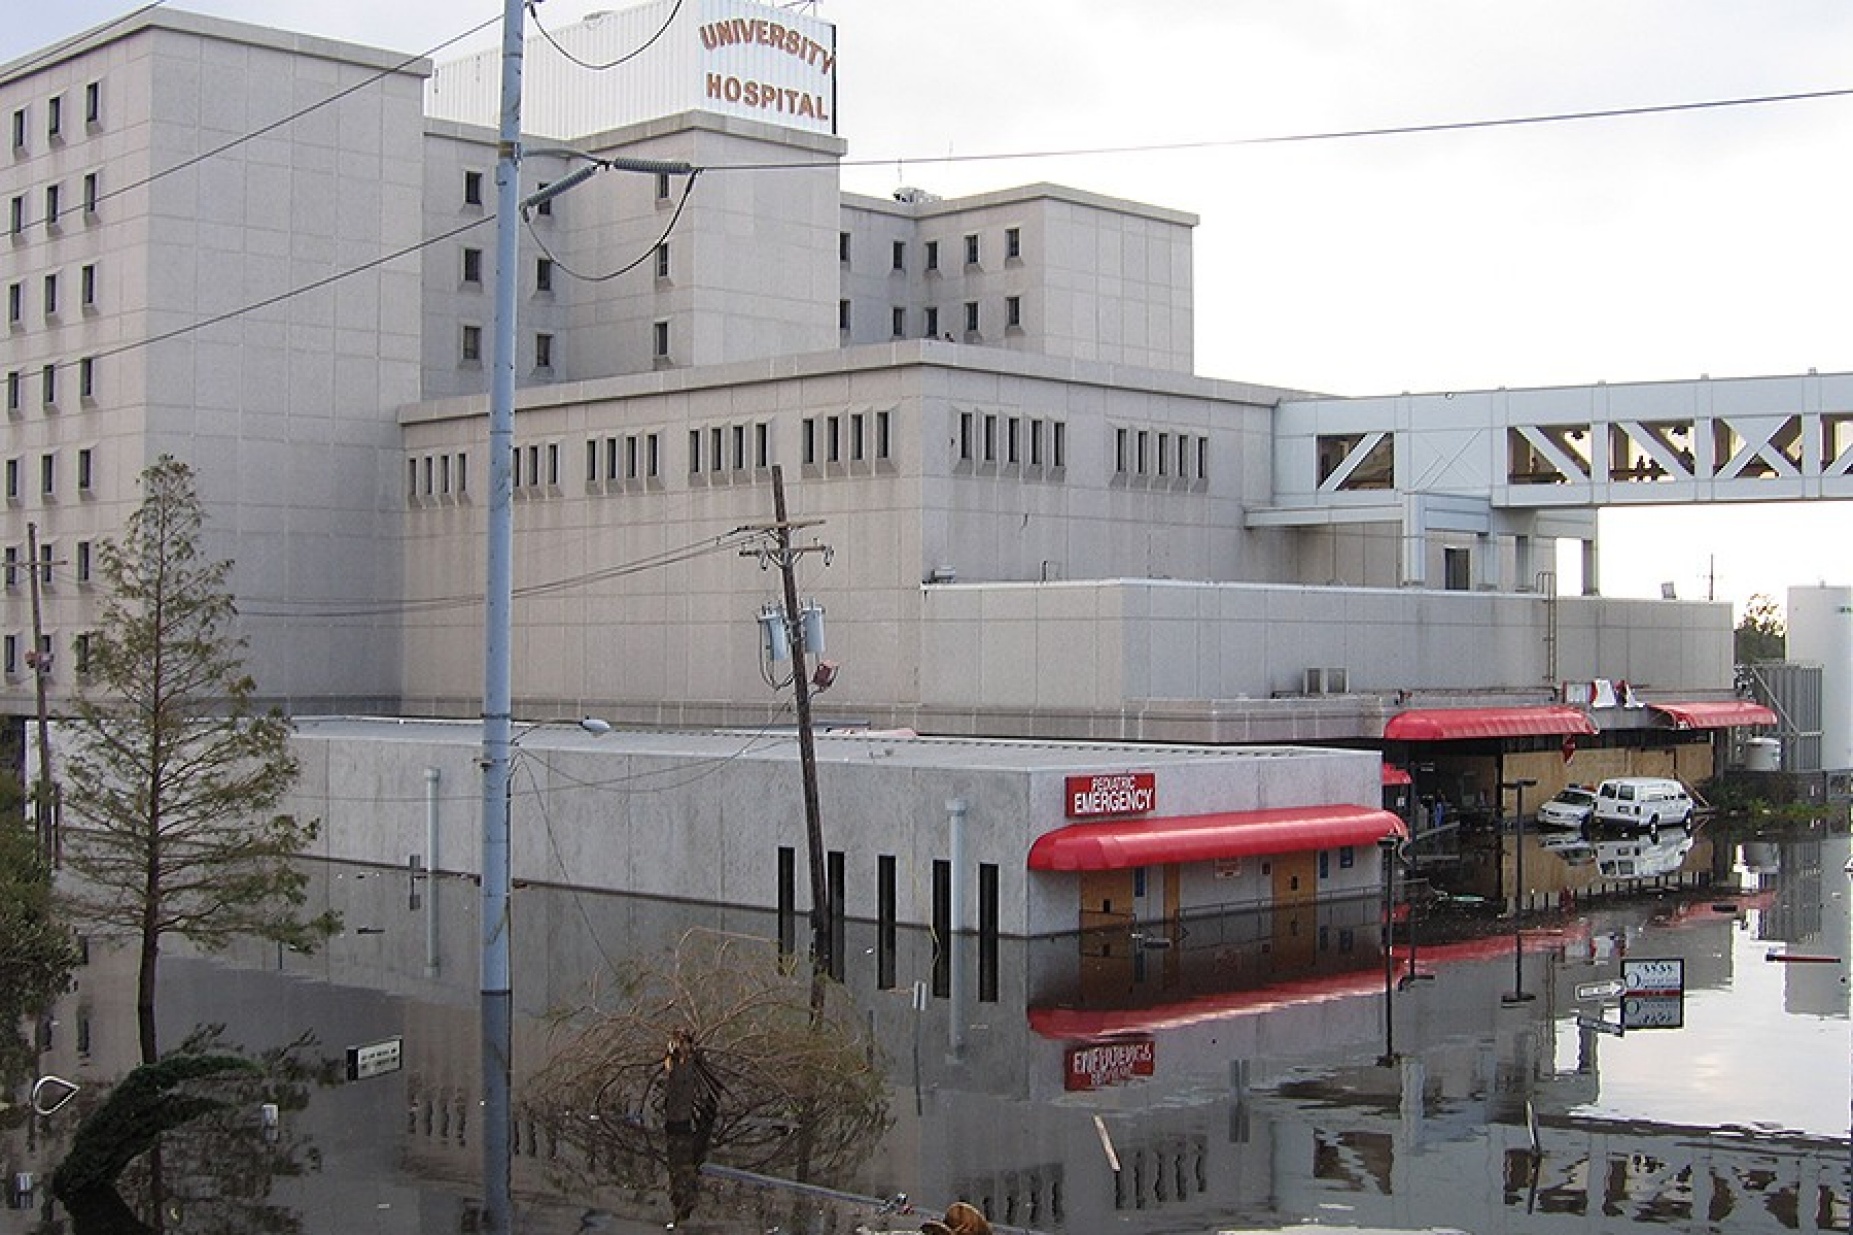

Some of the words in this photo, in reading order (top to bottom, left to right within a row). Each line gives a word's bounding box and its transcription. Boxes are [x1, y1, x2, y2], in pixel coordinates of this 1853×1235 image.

[699, 18, 834, 75] UNIVERSITY
[707, 72, 829, 121] HOSPITAL
[1074, 789, 1153, 814] EMERGENCY
